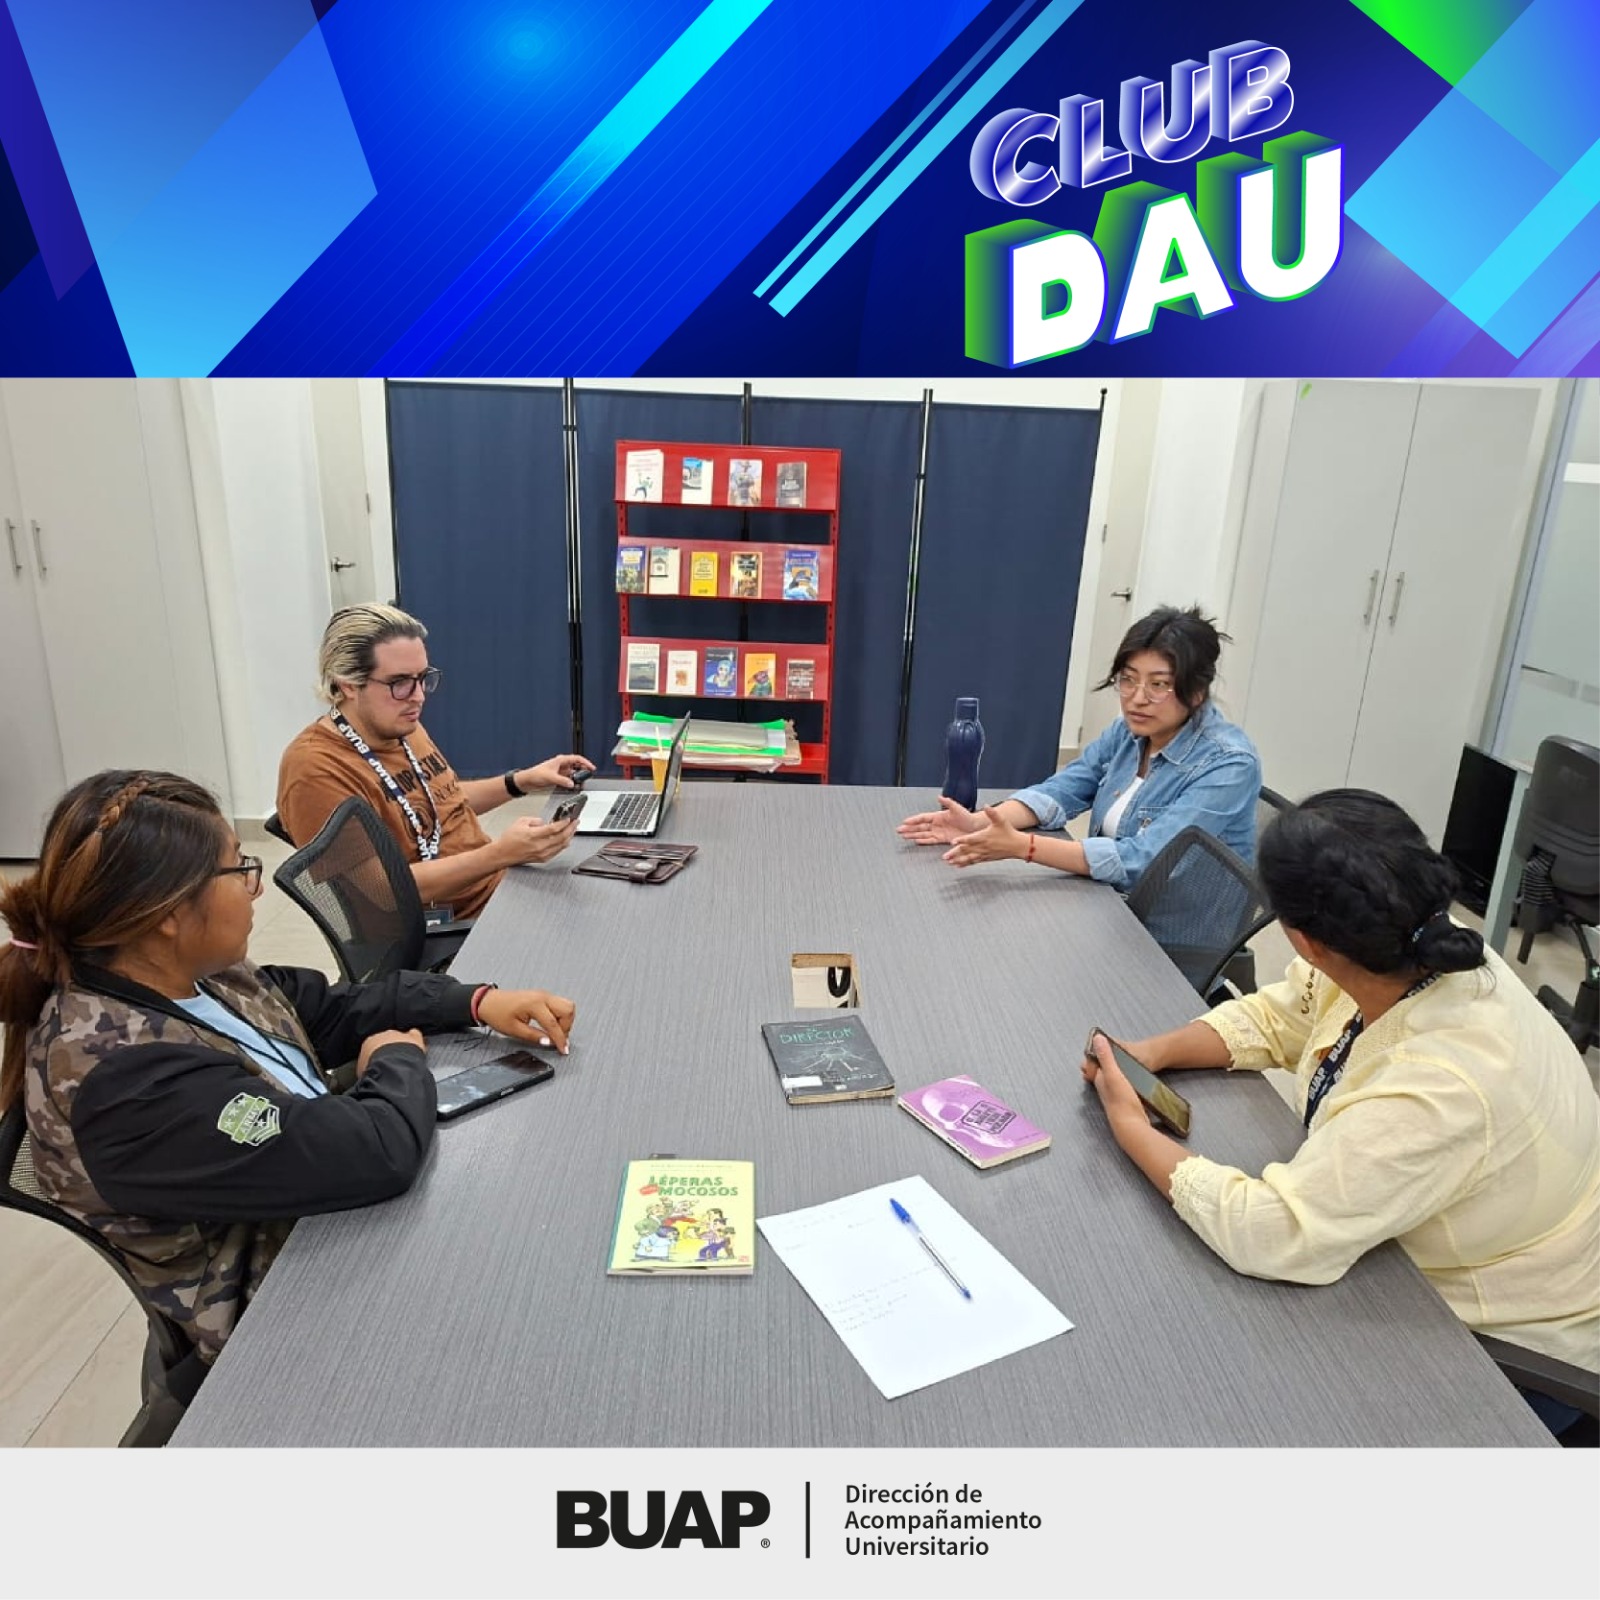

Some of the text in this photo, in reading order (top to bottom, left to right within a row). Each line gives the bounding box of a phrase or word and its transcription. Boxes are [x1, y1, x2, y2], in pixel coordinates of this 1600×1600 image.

[338, 723, 370, 755] BUAP
[368, 757, 398, 790] BUAP
[417, 834, 432, 861] UAP
[1328, 1029, 1352, 1062] BUAP
[1309, 1066, 1327, 1101] BUAP
[649, 1174, 724, 1187] LÉPERAS
[658, 1186, 739, 1197] MOCOSOS
